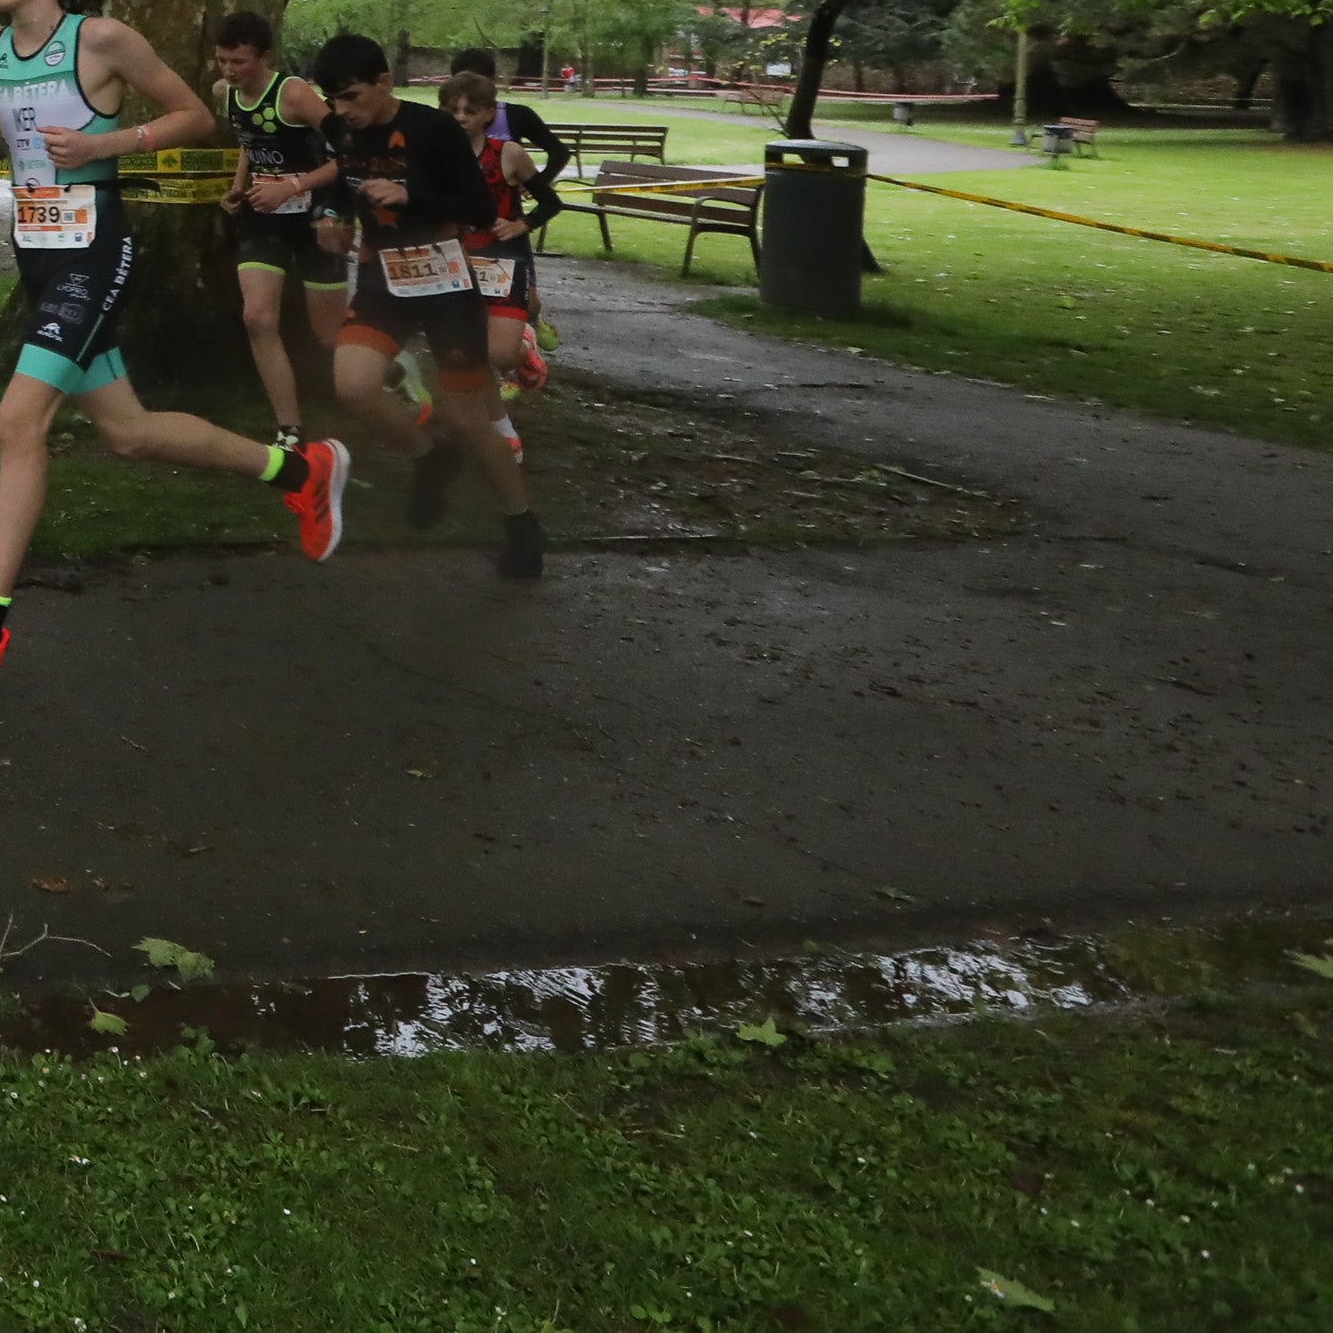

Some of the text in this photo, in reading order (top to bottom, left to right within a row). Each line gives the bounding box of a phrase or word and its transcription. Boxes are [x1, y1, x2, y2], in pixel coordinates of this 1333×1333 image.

[18, 205, 60, 224] 1739
[102, 236, 133, 311] CEA BÉTERA
[388, 262, 438, 281] 1811
